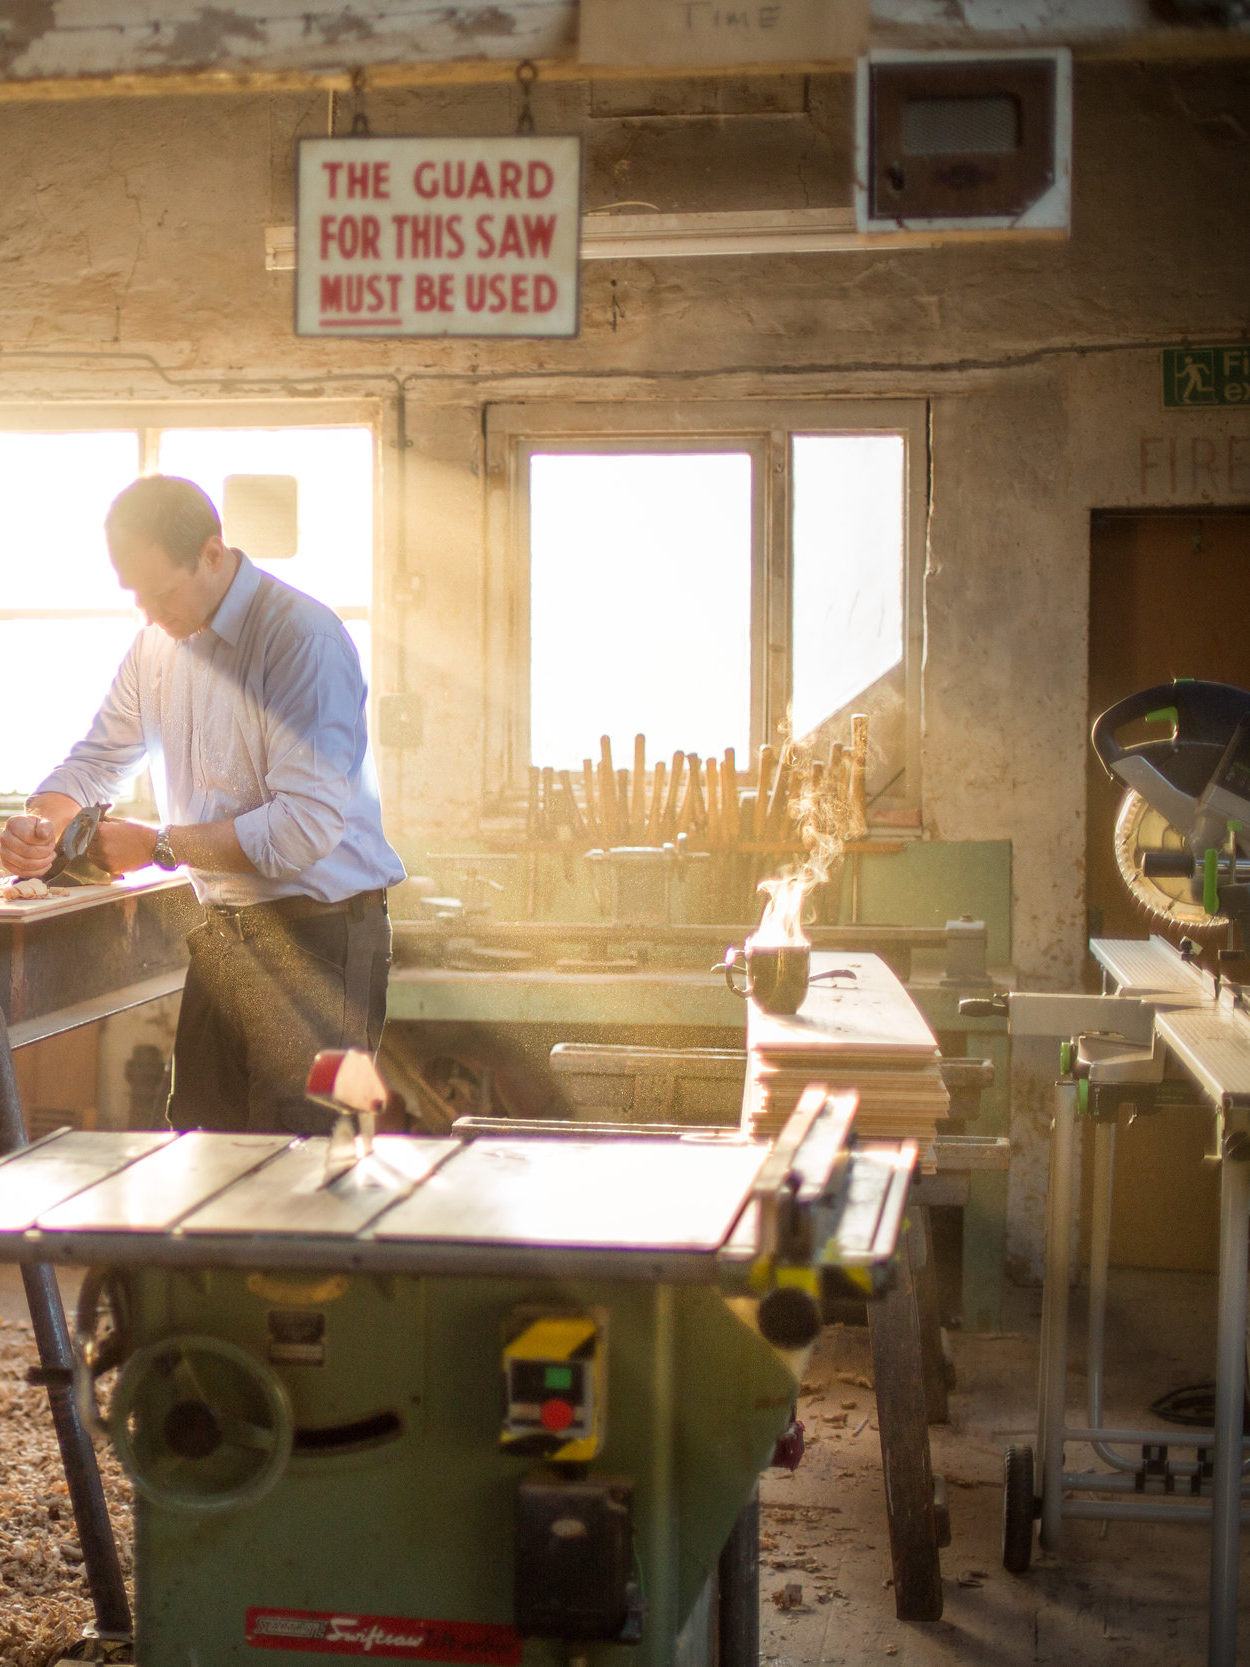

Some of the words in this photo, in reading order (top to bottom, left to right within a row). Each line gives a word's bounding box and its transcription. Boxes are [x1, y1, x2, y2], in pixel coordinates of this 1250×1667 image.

[676, 1, 782, 30] TIME
[321, 161, 391, 200] THE
[413, 160, 554, 200] GUARD
[319, 213, 381, 261] FOR
[391, 213, 466, 260] THIS
[475, 213, 557, 260] SAW
[318, 273, 402, 314] MUST
[413, 273, 455, 314] BE
[465, 273, 559, 314] USED
[1223, 351, 1250, 376] Fi
[1140, 436, 1250, 496] FIRE
[327, 1617, 423, 1651] Swiftsaw
